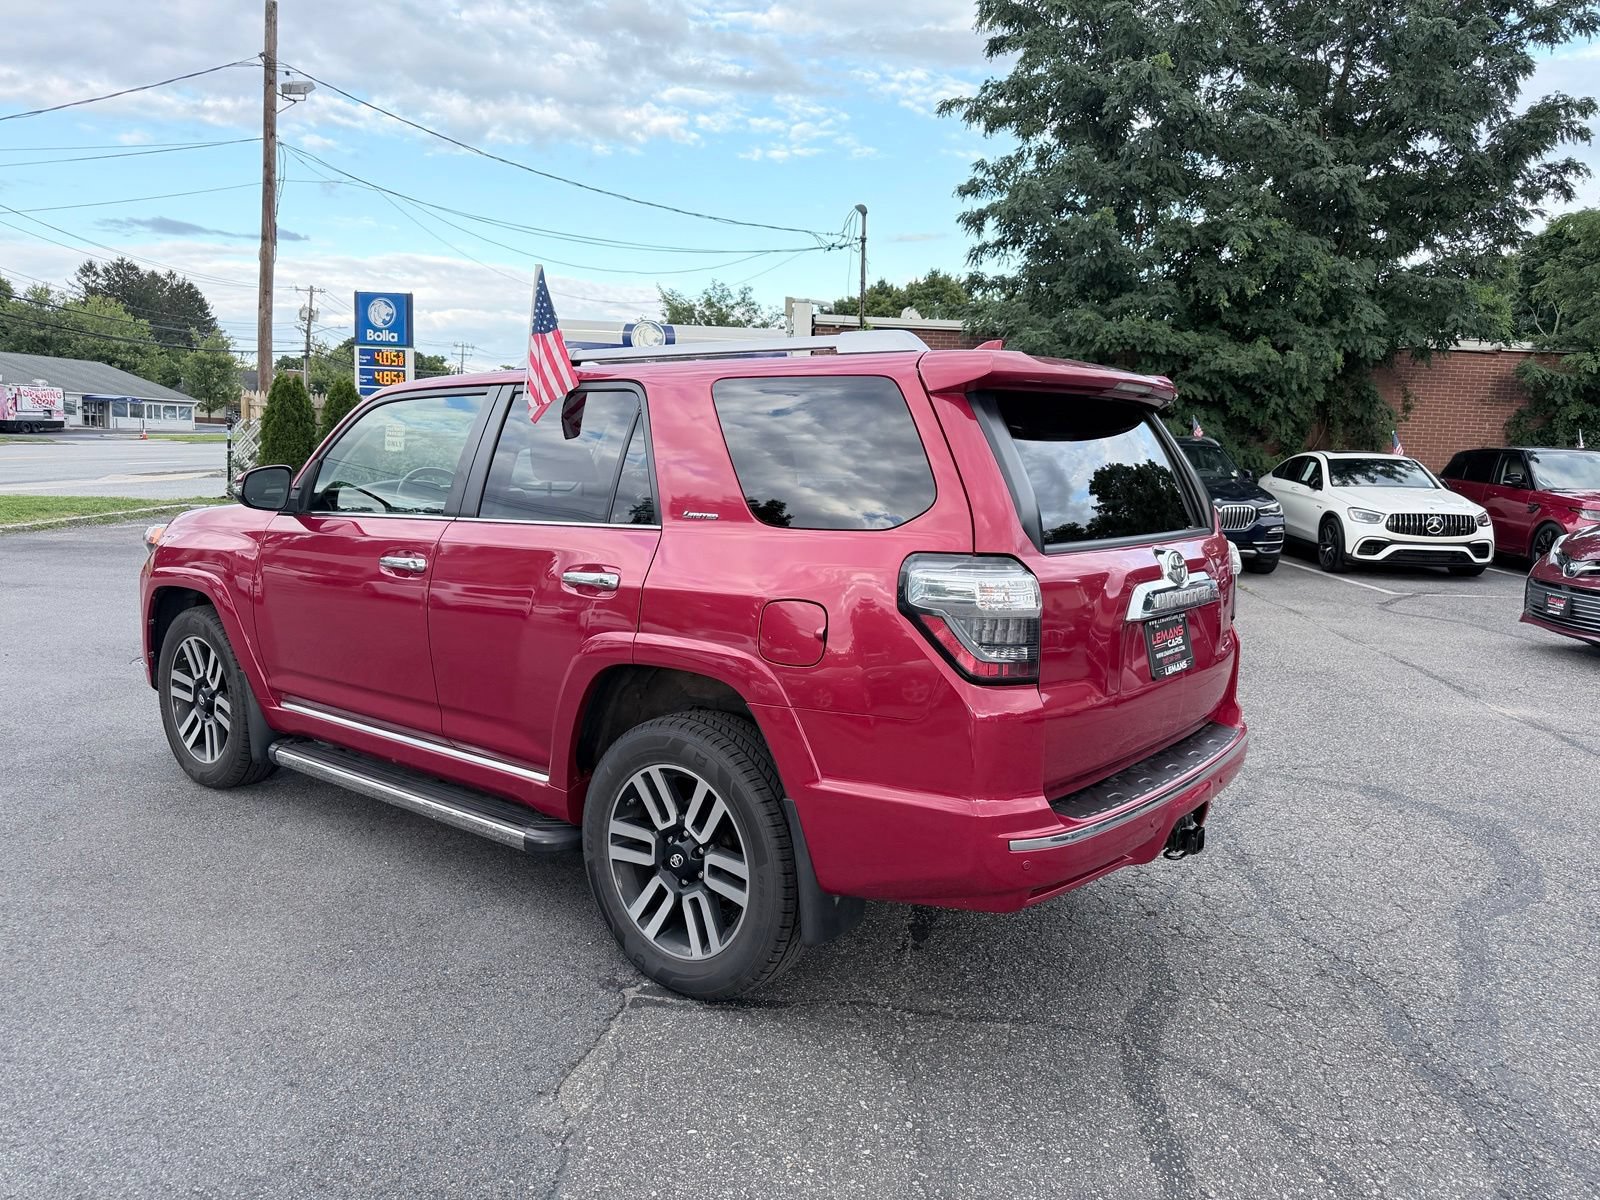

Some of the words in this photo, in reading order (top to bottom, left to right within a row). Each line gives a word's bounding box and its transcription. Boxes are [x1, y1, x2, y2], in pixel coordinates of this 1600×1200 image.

[366, 329, 398, 342] Bolla
[22, 389, 62, 399] OPENING
[1152, 625, 1184, 644] LEMANS
[1167, 636, 1183, 648] CARS
[1164, 660, 1188, 675] LEMANS
